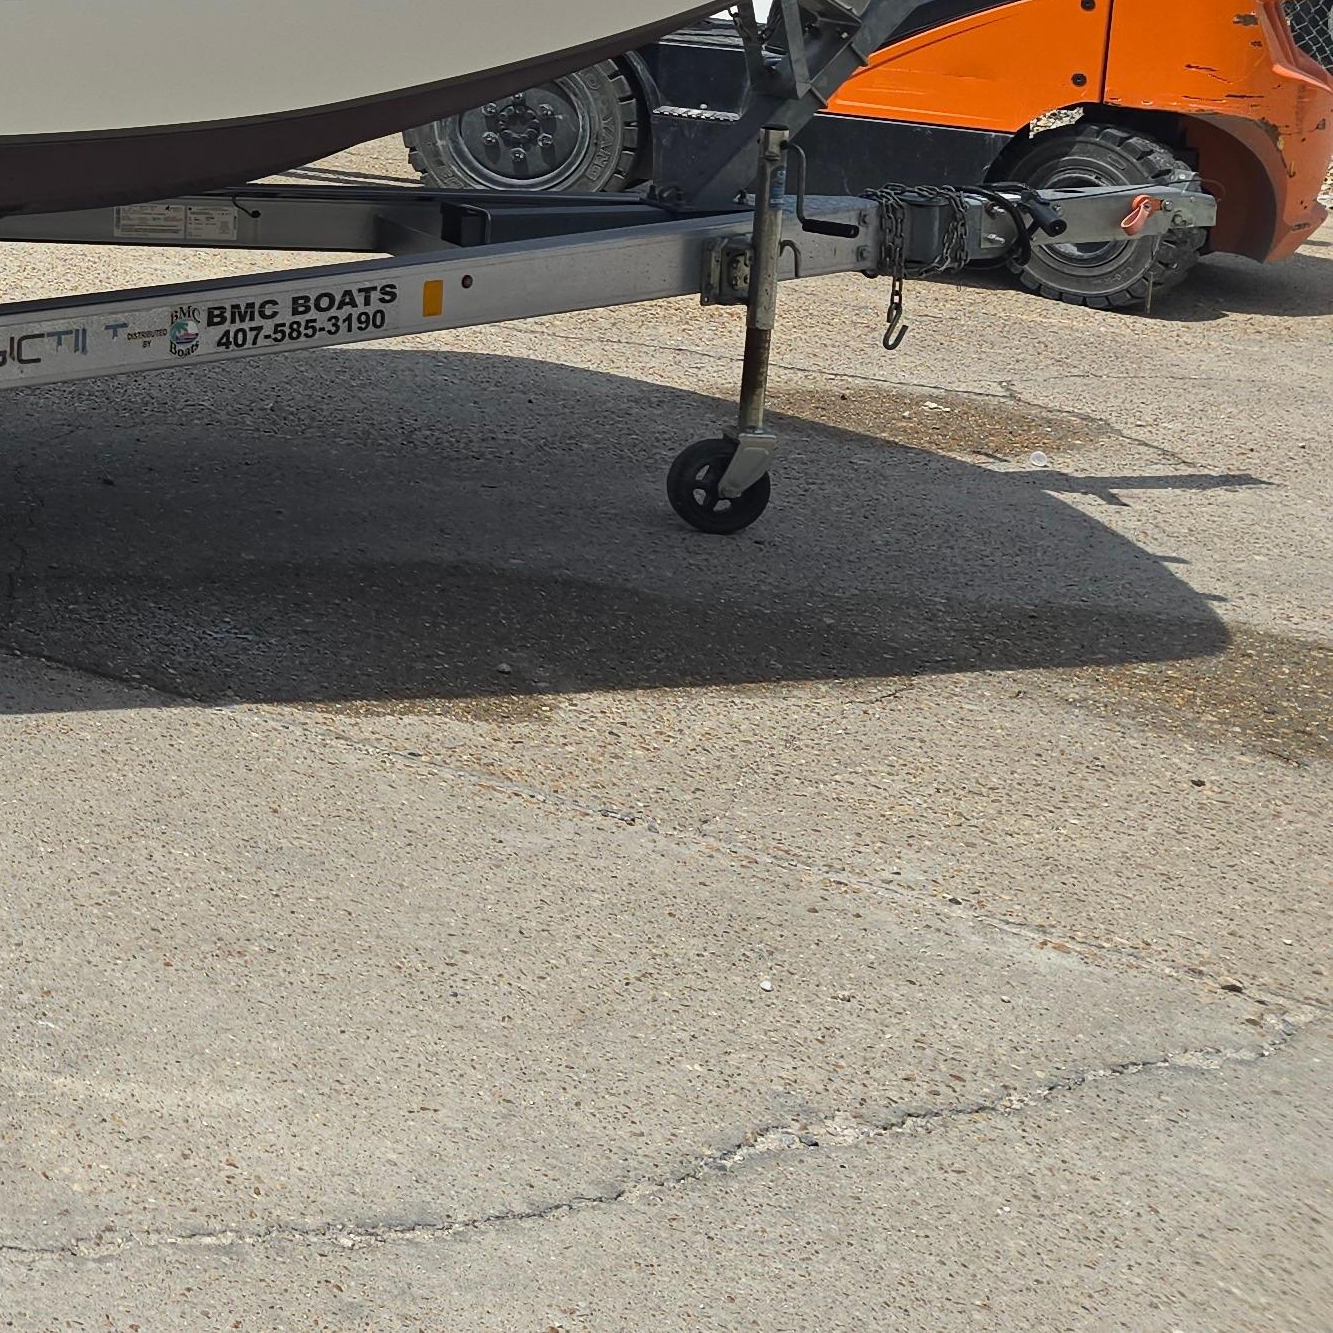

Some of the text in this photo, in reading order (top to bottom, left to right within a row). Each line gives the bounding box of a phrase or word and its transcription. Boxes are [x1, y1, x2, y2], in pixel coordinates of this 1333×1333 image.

[170, 305, 201, 326] BMC
[207, 283, 398, 327] BMC BOATS
[216, 309, 386, 350] 407-585-3190
